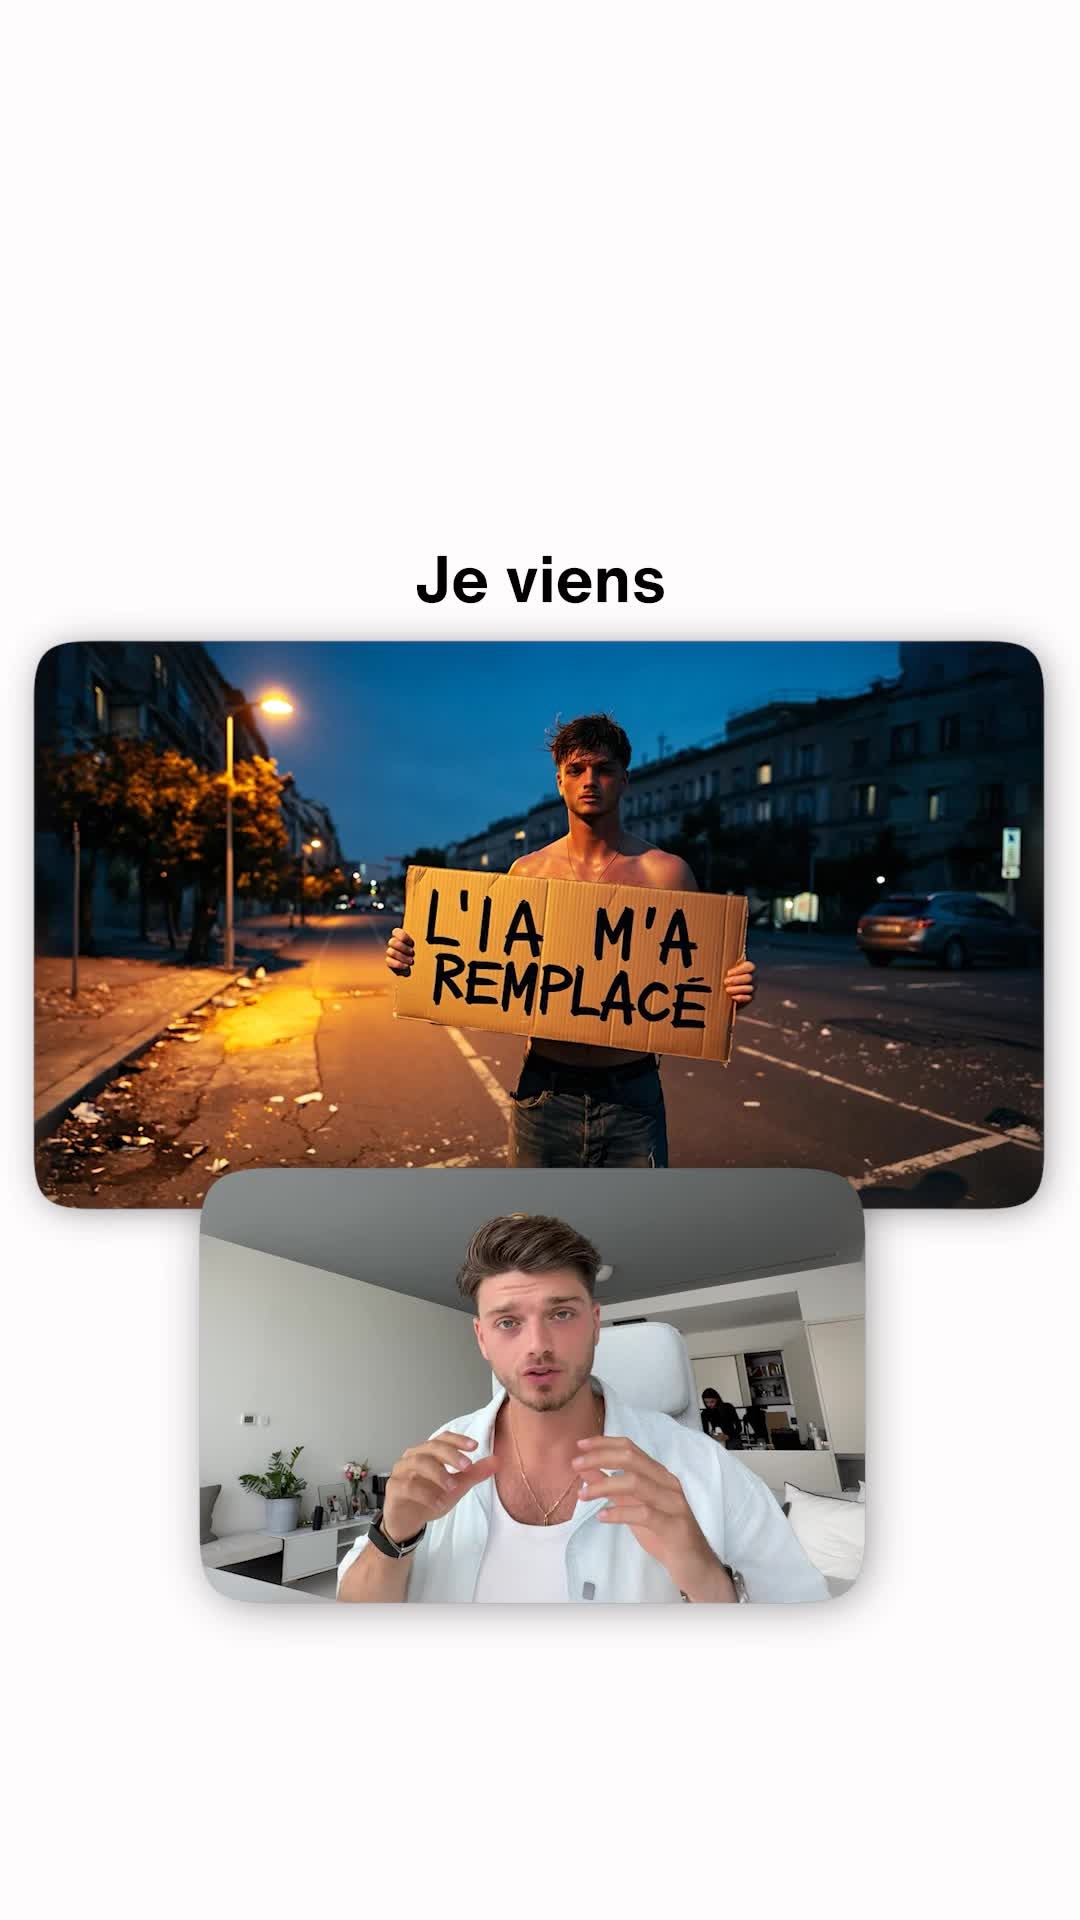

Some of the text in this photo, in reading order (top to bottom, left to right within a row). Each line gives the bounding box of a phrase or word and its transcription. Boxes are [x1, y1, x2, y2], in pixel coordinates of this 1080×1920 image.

[426, 888, 698, 968] L'IA M'A
[433, 953, 712, 1028] REMPLACÉ
